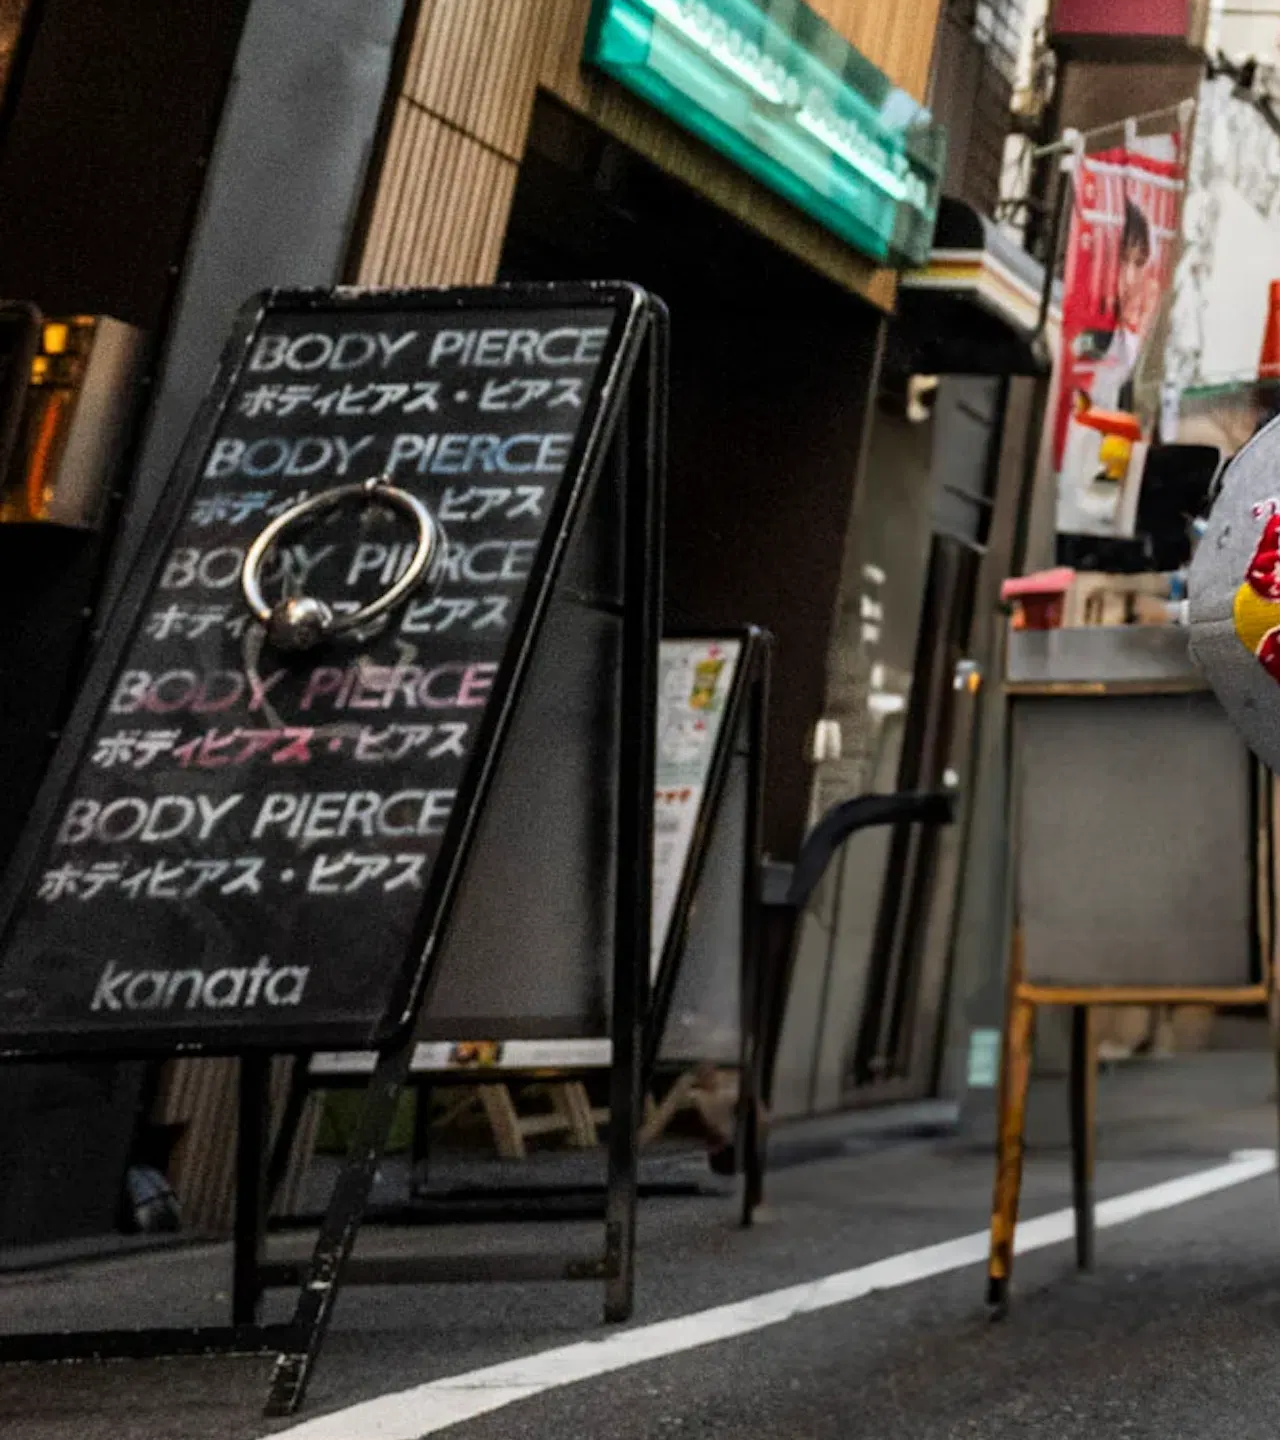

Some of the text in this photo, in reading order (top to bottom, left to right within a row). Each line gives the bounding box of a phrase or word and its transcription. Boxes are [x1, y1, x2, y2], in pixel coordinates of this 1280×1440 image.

[248, 325, 609, 373] BODY PIERCE
[202, 432, 575, 478] BODY PIERCE
[107, 661, 500, 715] BODY PIERCE
[54, 788, 459, 844] BODY PIERCE
[89, 953, 311, 1012] kanata
